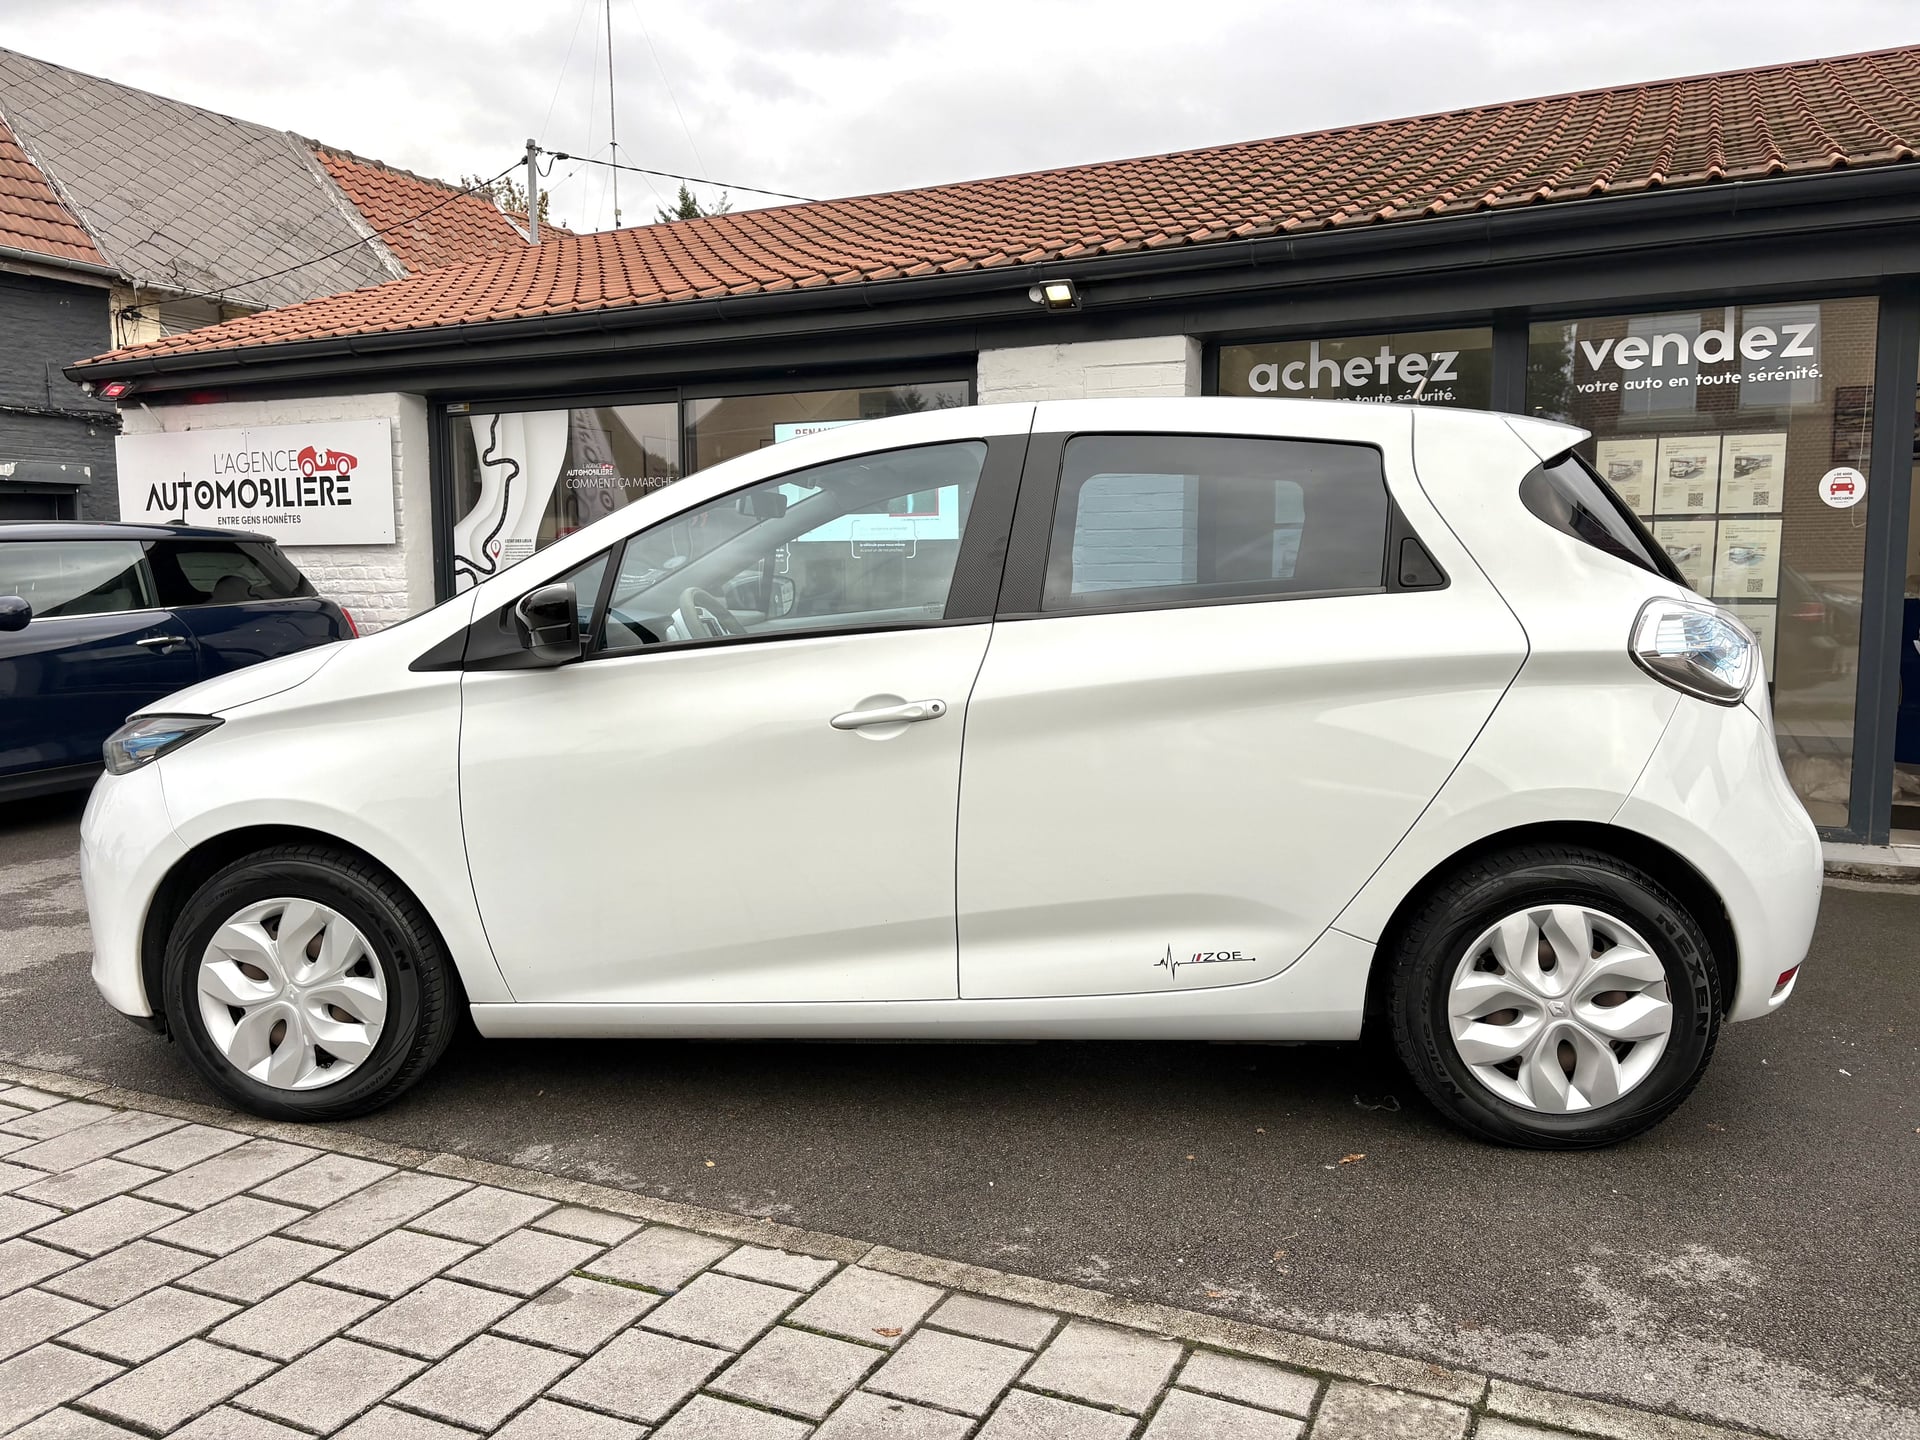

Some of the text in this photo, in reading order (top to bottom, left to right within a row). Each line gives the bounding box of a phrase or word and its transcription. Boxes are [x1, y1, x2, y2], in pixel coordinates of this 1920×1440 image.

[1580, 306, 1816, 371] vendez
[1248, 341, 1460, 393] achetez
[1576, 363, 1823, 394] votre auto en toute sérénité.
[1357, 392, 1392, 403] toute
[1397, 387, 1457, 402] séurité.
[213, 449, 298, 475] L'AGENCE
[565, 477, 615, 489] COMMENT
[617, 476, 631, 490] ÇA
[217, 511, 302, 526] ENTRE GENS HONNÊTES
[1203, 951, 1243, 962] ZOE
[1655, 912, 1711, 1037] NEXEN
